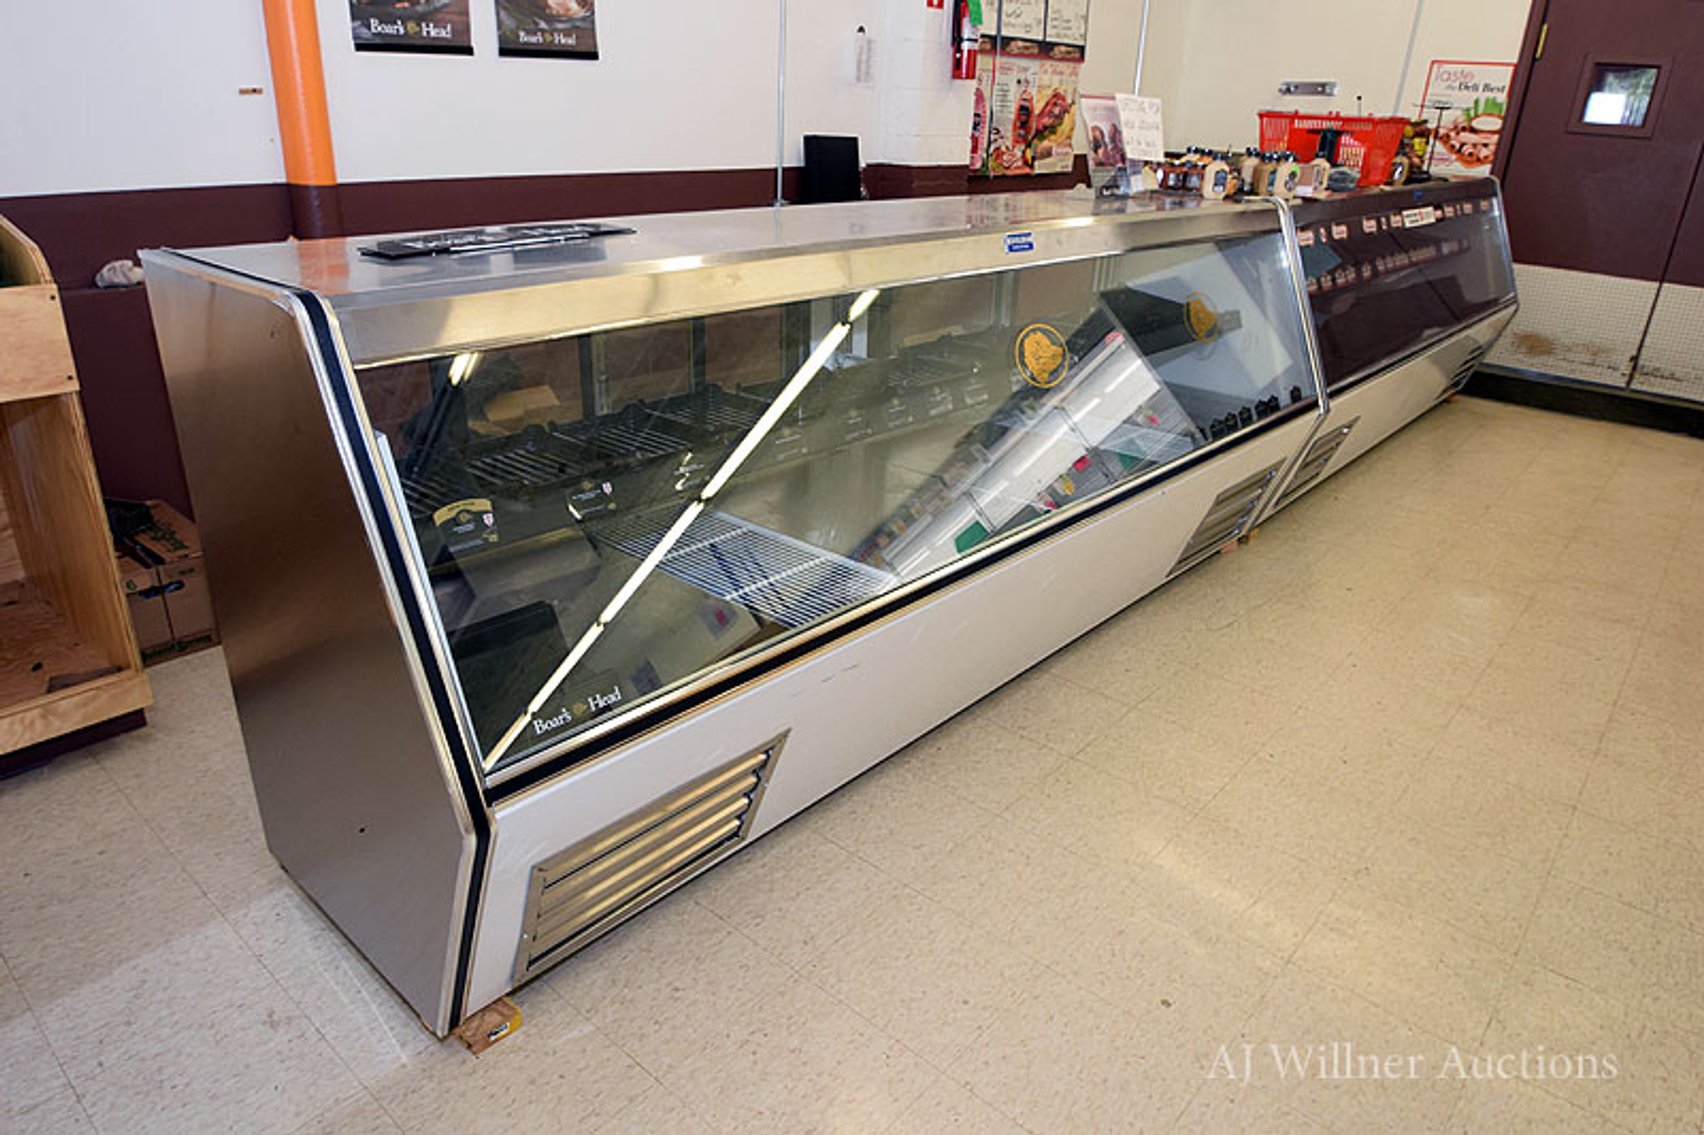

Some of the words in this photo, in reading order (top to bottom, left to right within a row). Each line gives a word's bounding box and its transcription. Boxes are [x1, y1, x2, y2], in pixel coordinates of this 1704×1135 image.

[370, 18, 405, 35] Boar's
[421, 21, 452, 38] Head
[1434, 64, 1475, 82] Taste
[1458, 81, 1480, 92] Deli
[1482, 83, 1506, 93] Best
[533, 706, 572, 735] Boar's
[587, 685, 622, 712] Head
